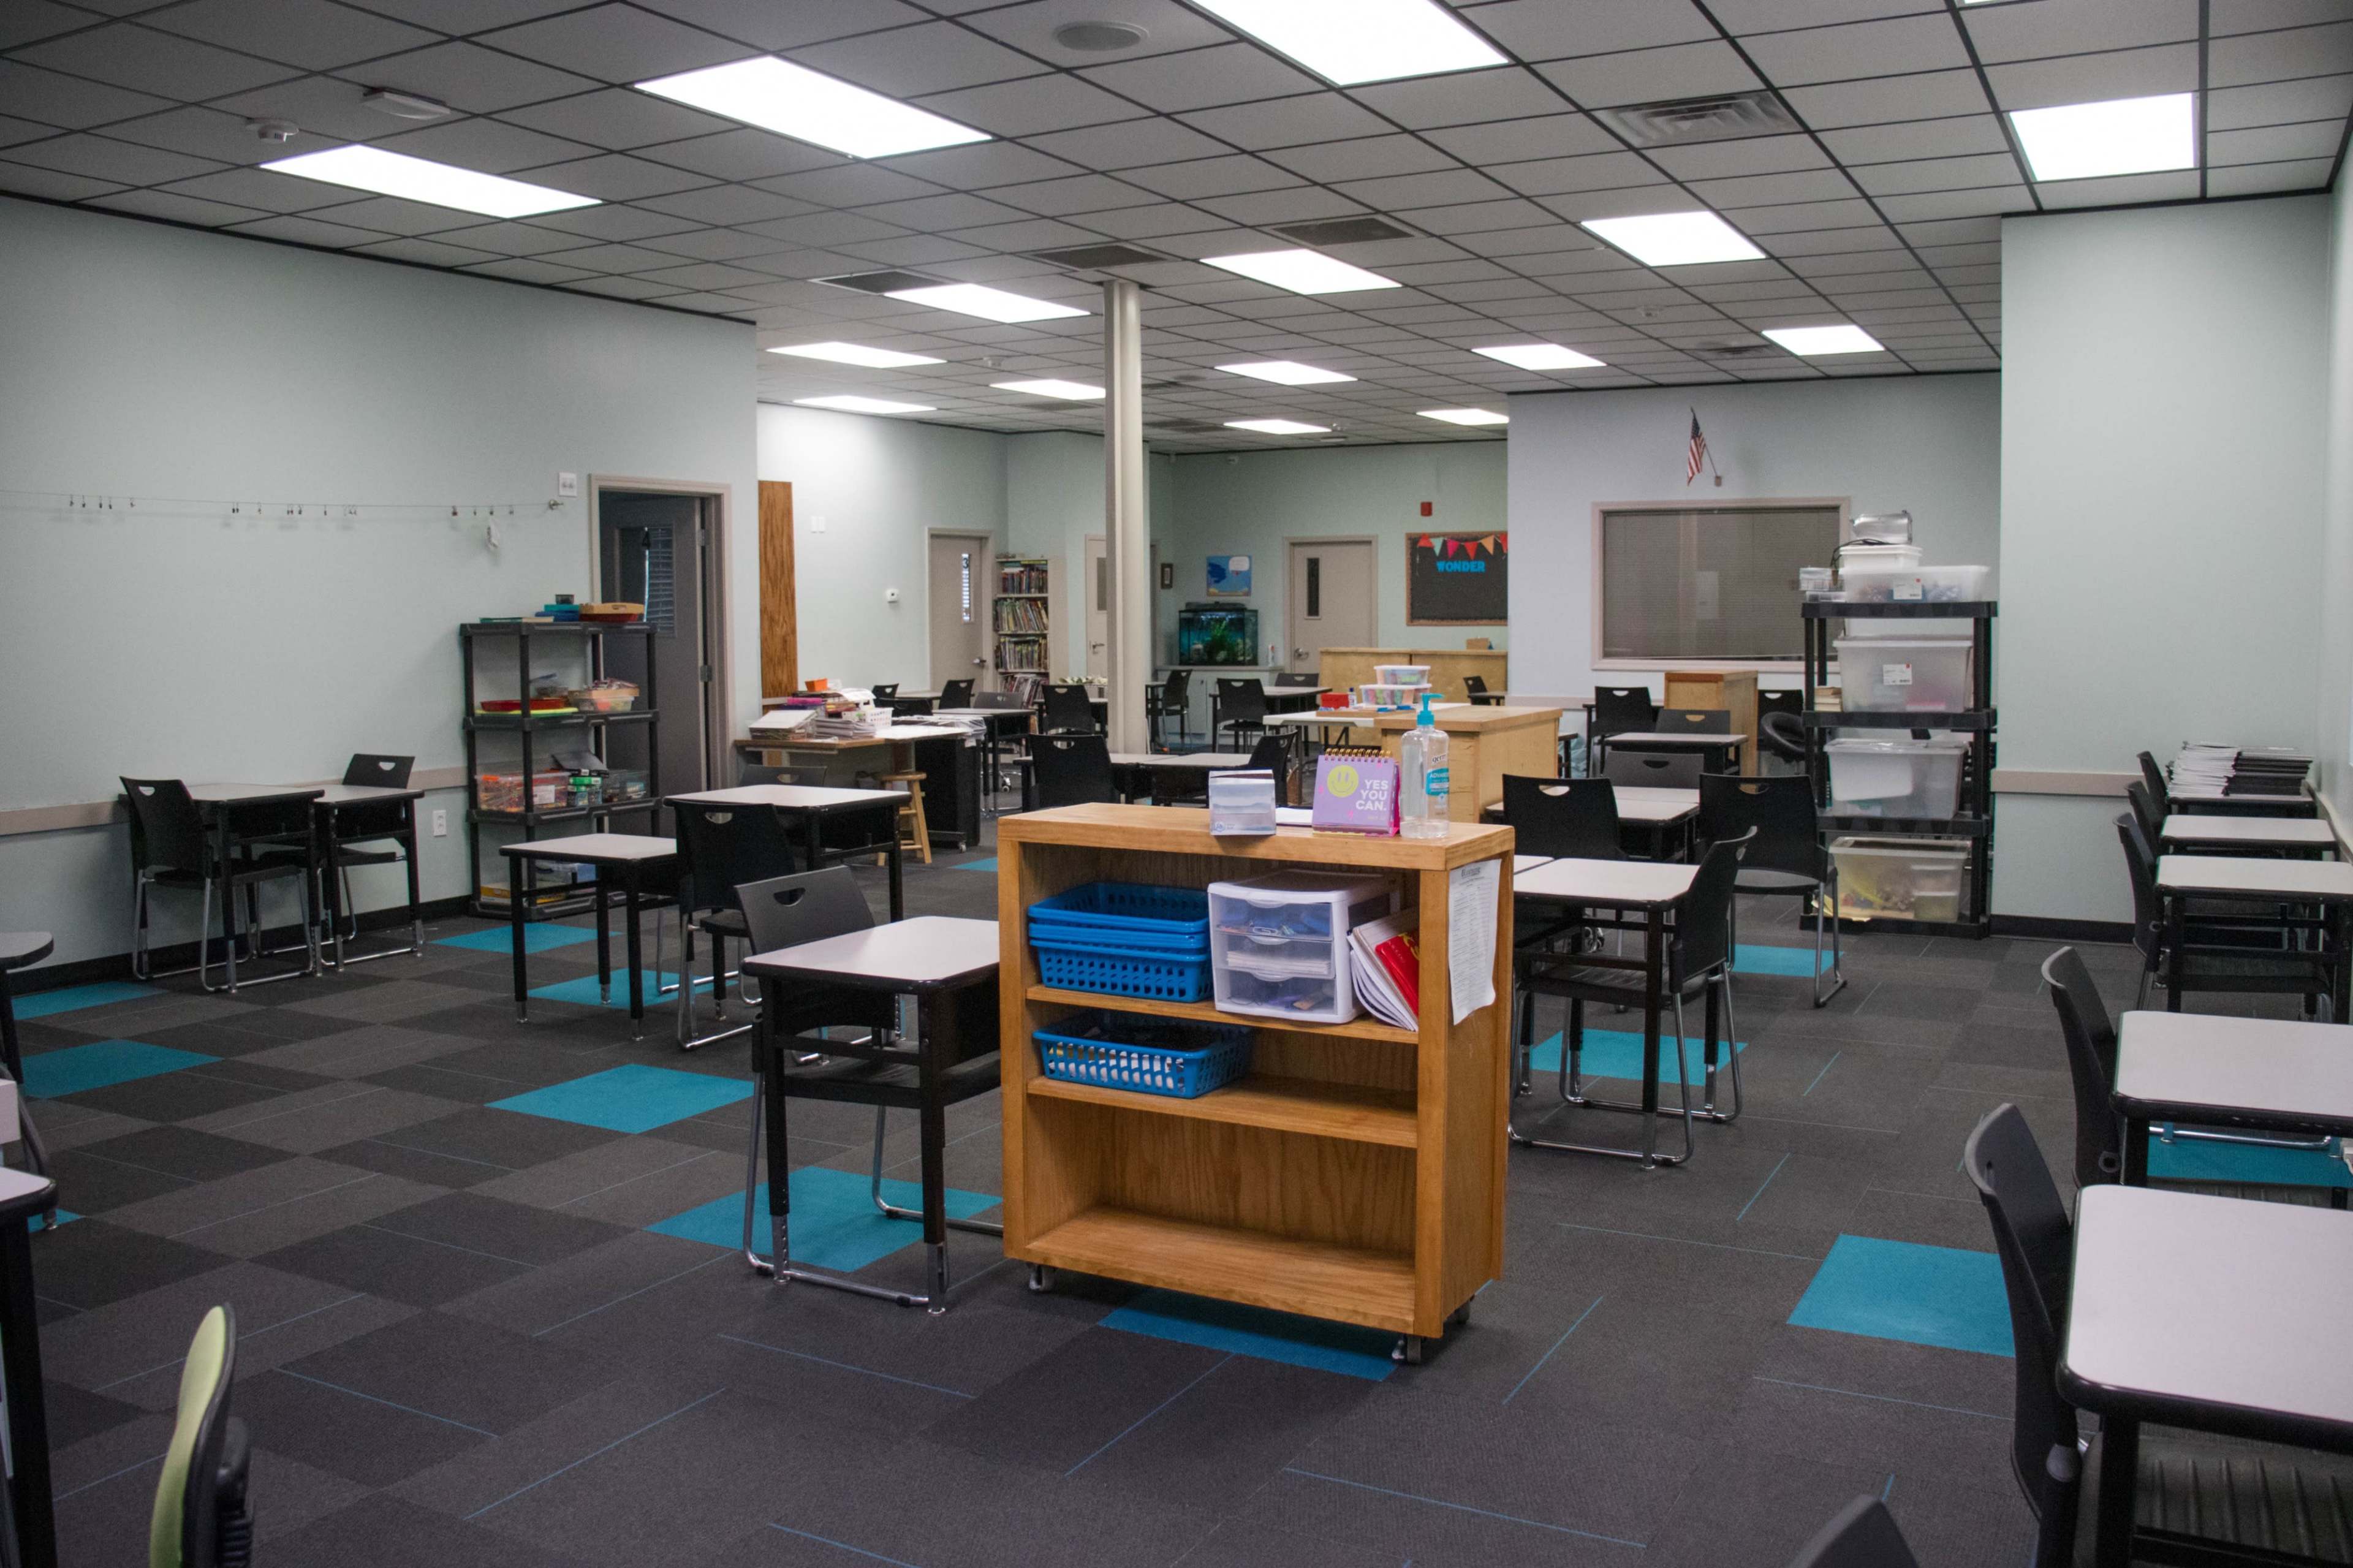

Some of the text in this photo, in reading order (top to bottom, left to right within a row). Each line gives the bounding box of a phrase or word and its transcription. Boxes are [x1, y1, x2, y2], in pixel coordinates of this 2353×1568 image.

[1436, 560, 1485, 573] WONDER
[1364, 779, 1389, 790] YES
[1360, 790, 1387, 800] YOU
[1355, 800, 1387, 810] CAN.
